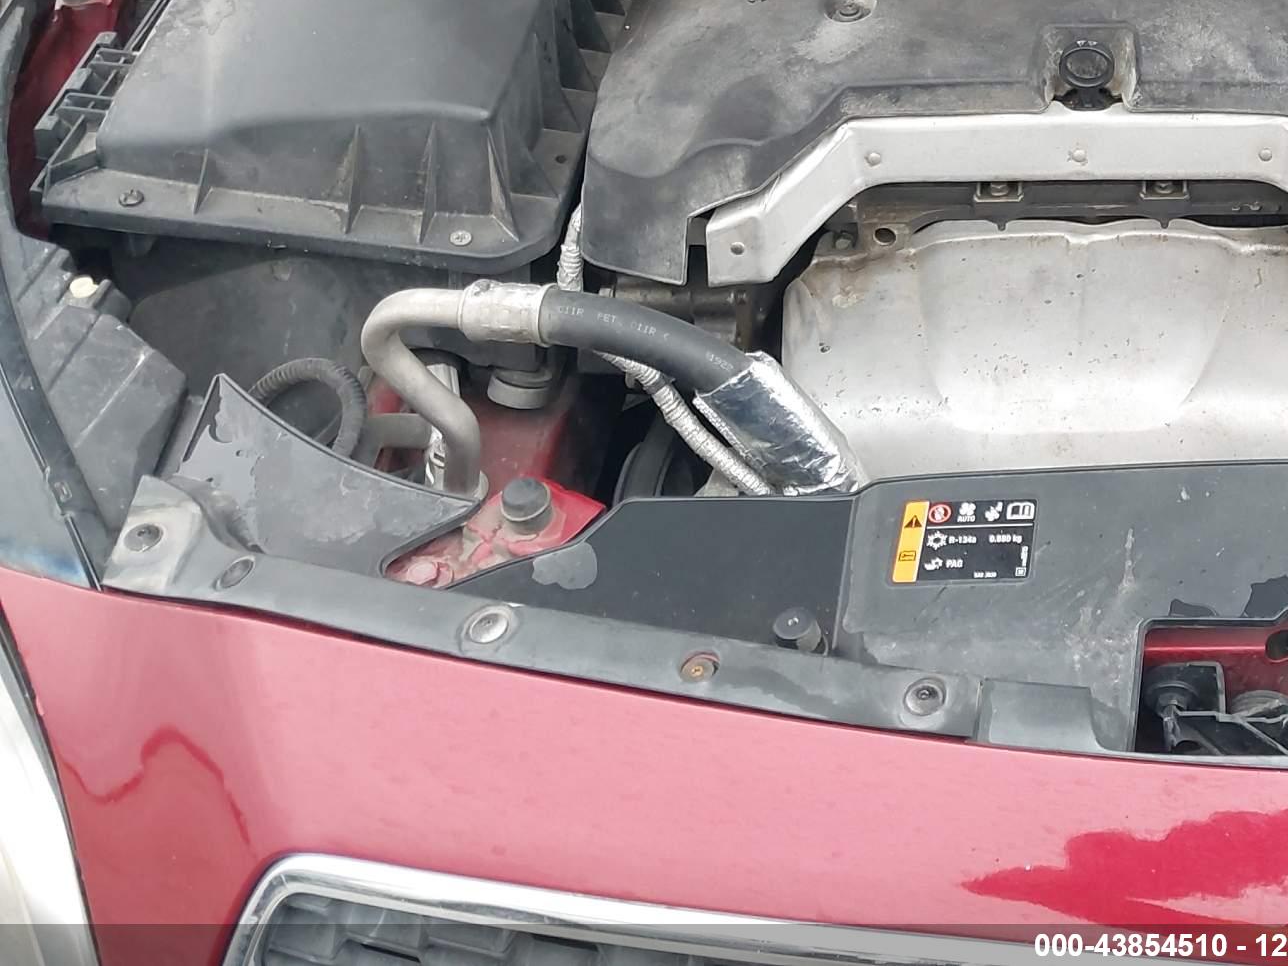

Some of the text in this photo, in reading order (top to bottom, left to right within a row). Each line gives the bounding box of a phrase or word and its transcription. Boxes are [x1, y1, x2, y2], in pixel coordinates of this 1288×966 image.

[957, 515, 976, 523] AUTO
[1012, 534, 1022, 544] kg
[946, 559, 963, 568] PAG
